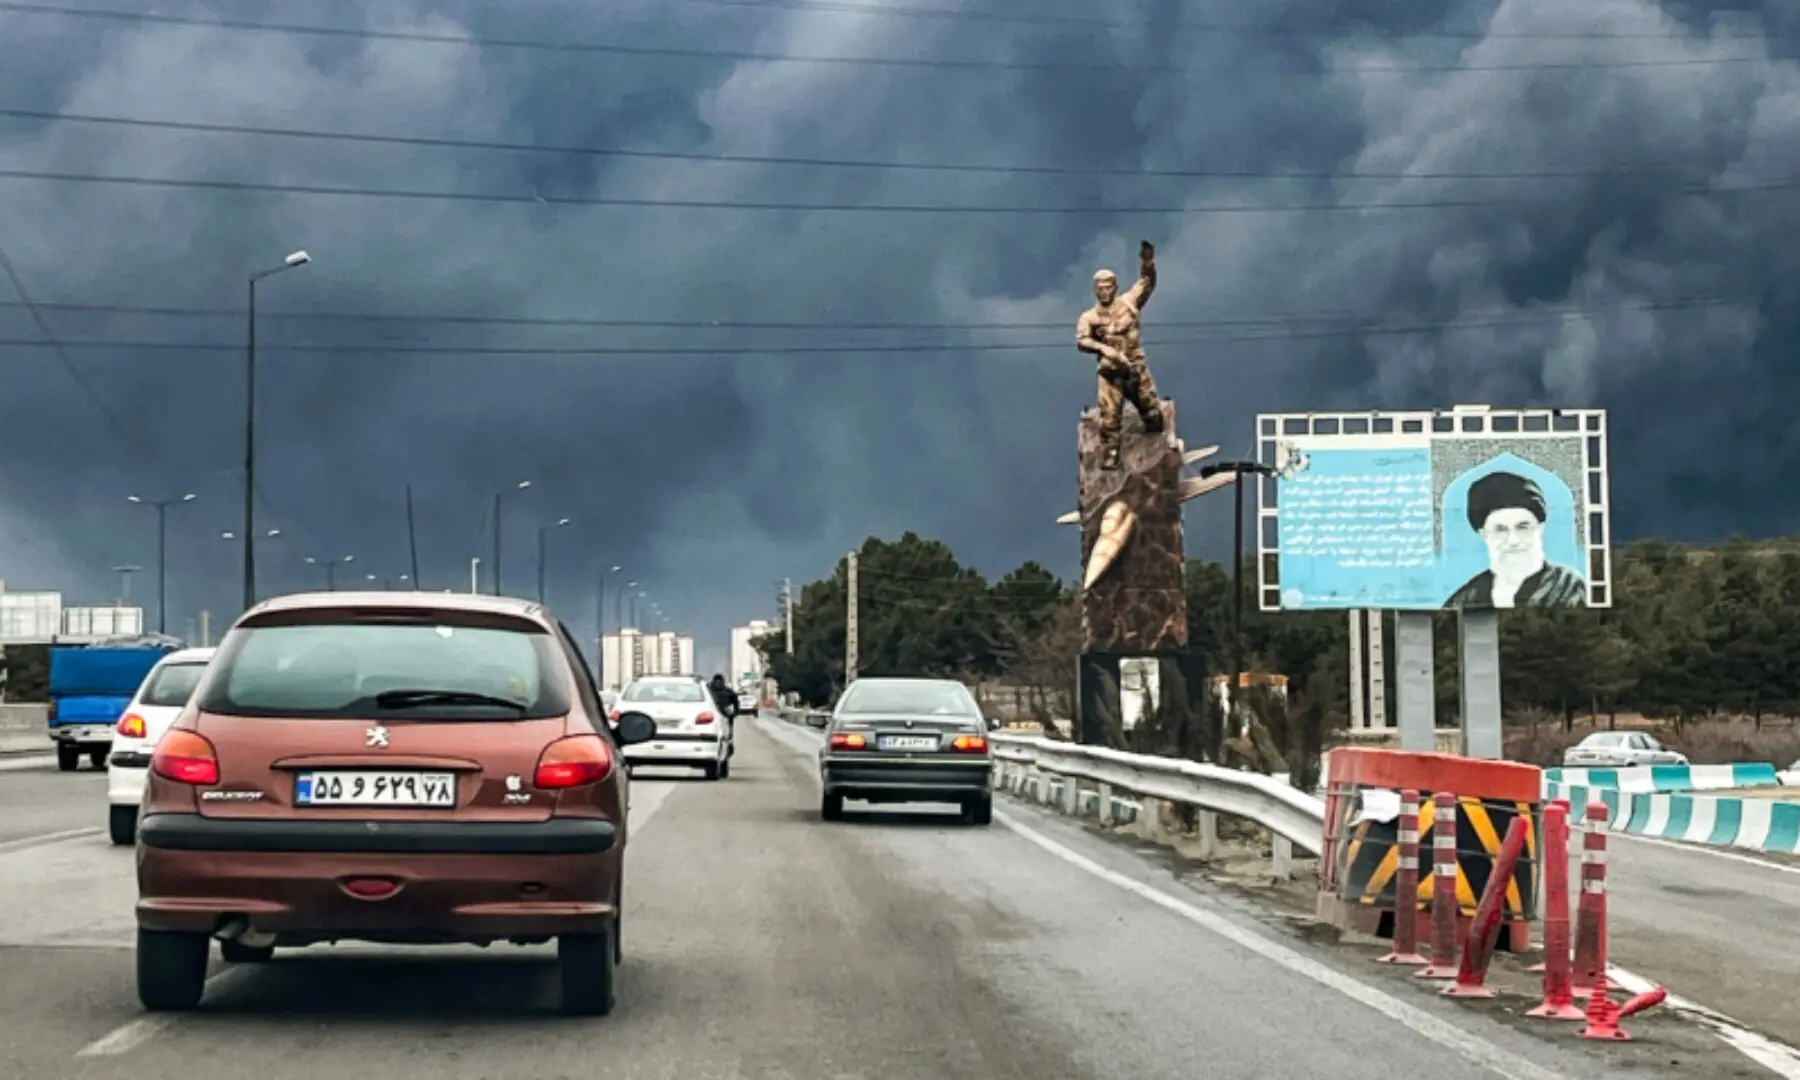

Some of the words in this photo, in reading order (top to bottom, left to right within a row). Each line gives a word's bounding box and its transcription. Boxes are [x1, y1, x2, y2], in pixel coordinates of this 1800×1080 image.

[314, 775, 343, 799] ۵۵
[372, 775, 418, 799] ۶۲۹
[423, 780, 451, 802] ۷۸
